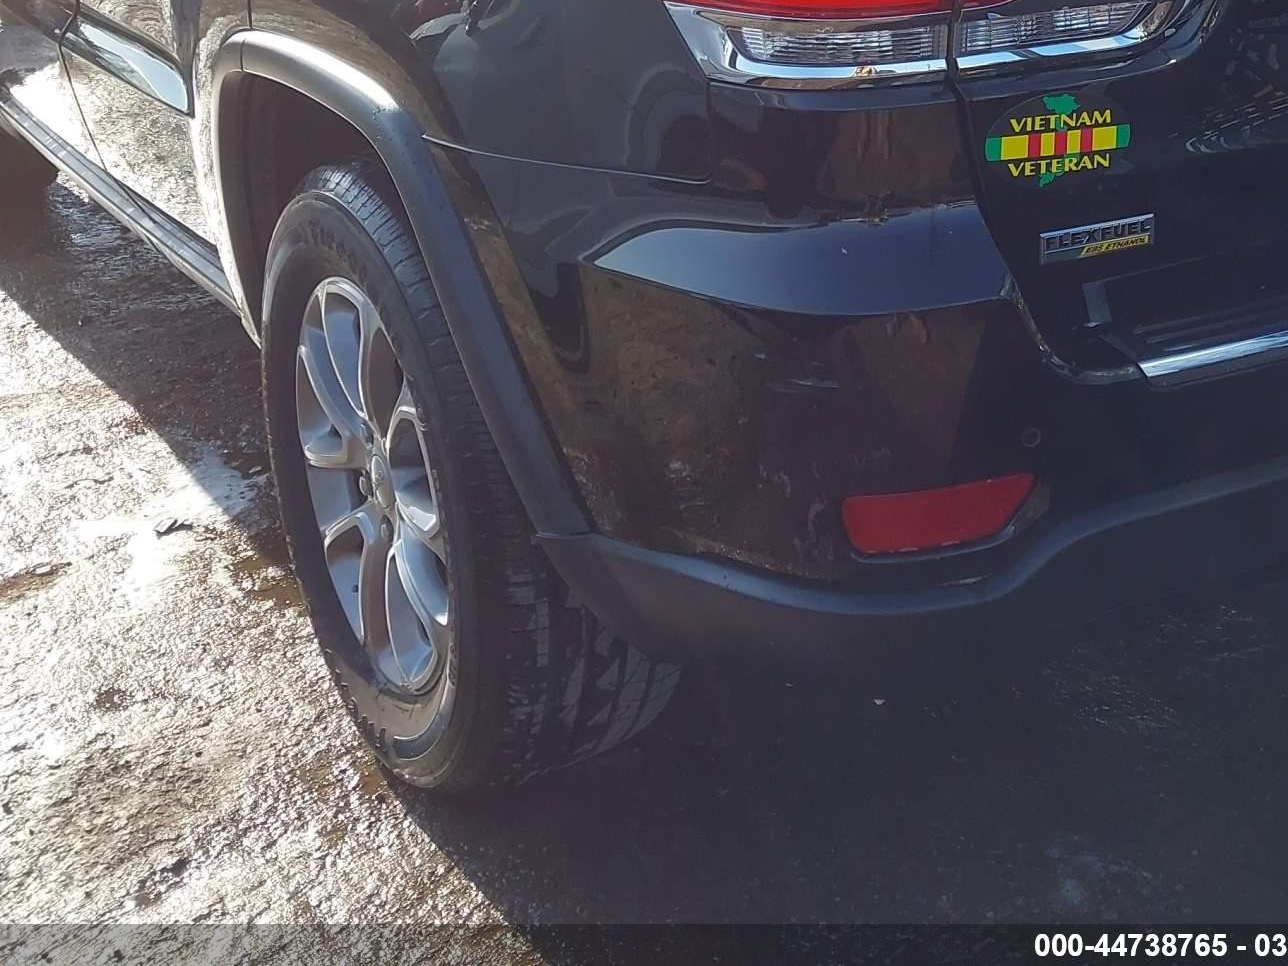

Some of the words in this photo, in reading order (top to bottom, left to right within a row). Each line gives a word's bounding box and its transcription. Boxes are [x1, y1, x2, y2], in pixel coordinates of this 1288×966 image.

[1009, 109, 1112, 133] VIETNAM
[1007, 153, 1110, 177] VETERAN
[1044, 220, 1151, 251] FLEXFUEL
[1105, 235, 1147, 250] ETHANOL
